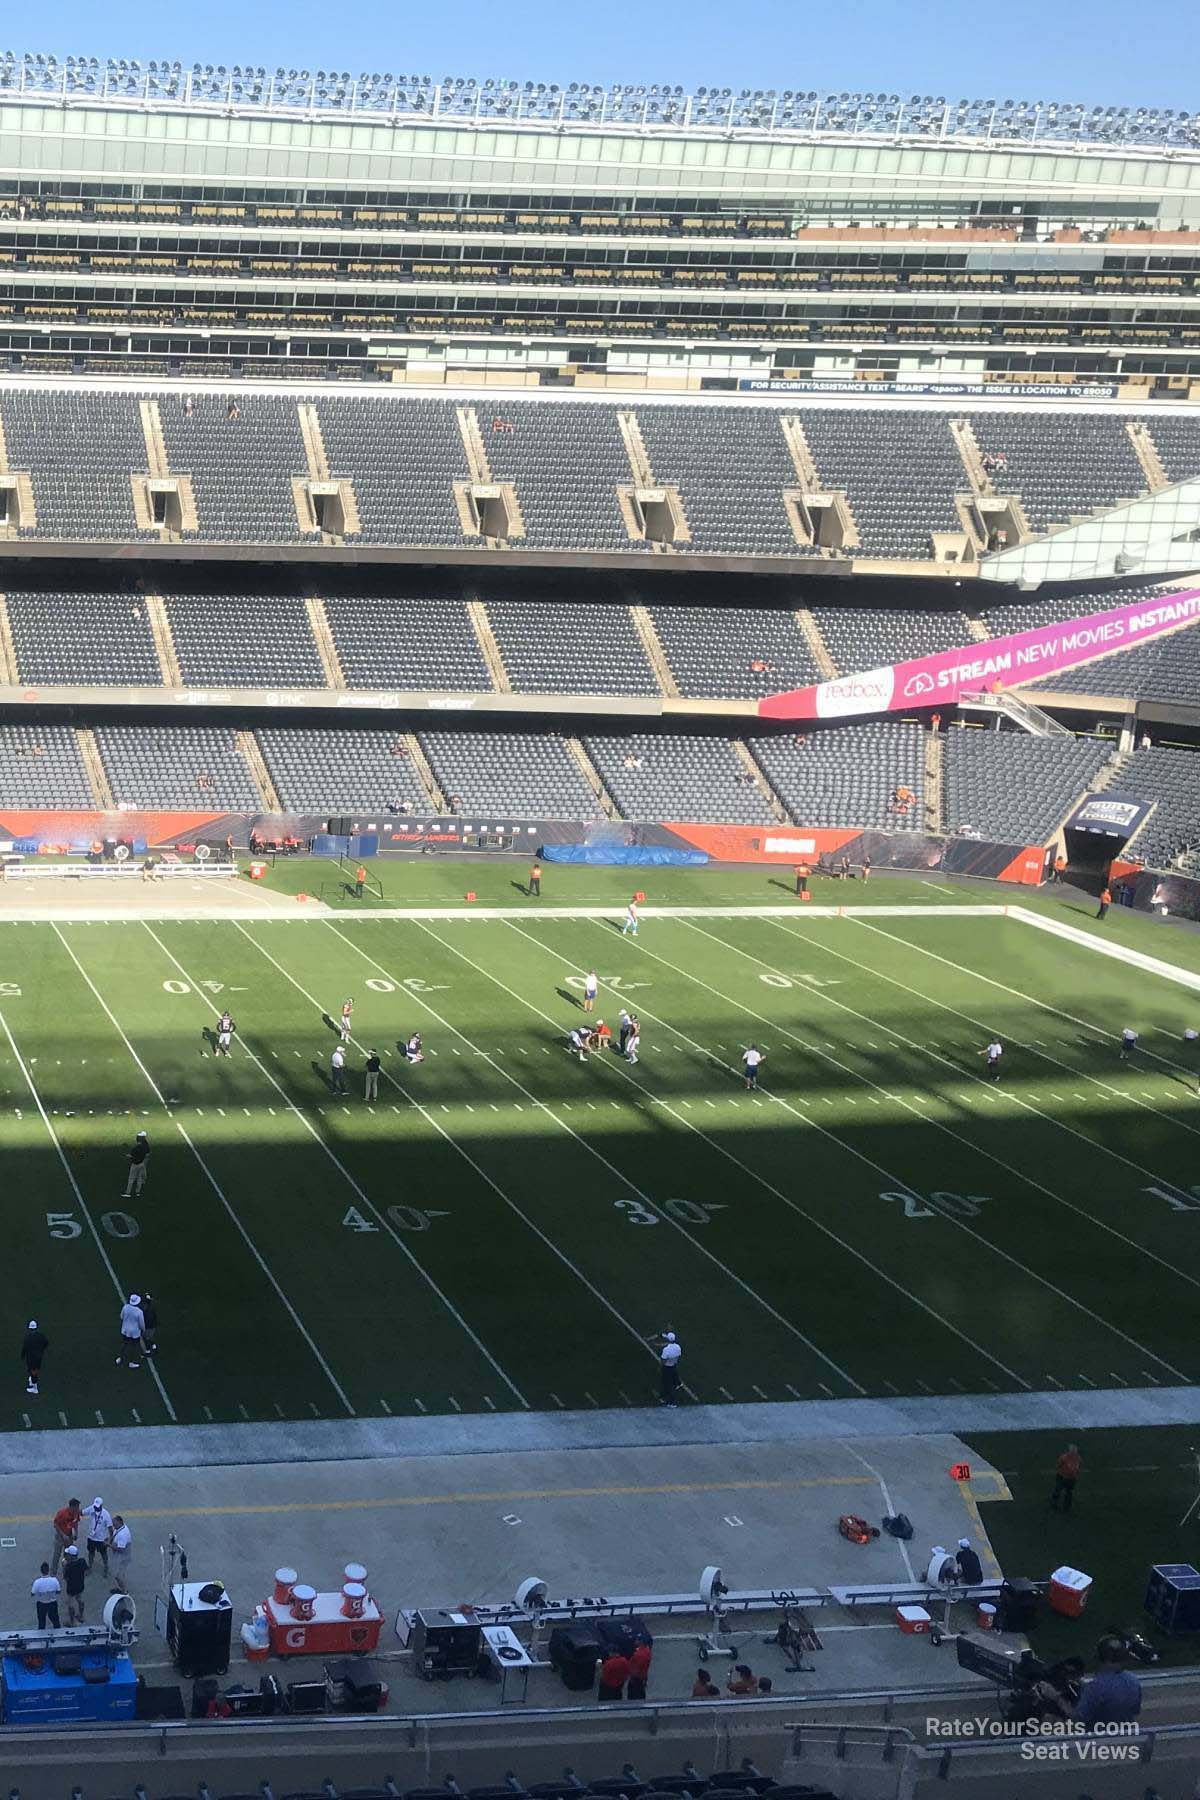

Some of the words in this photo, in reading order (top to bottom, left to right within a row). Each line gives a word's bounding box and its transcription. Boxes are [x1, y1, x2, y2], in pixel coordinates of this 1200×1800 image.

[751, 381, 768, 389] FOR
[868, 383, 889, 391] TEXT
[986, 386, 1011, 394] ISSUE
[1021, 387, 1069, 395] LOCATION
[1084, 388, 1113, 396] 69050
[937, 653, 1012, 688] STREAM
[1017, 640, 1058, 665] NEW
[1062, 619, 1125, 653] MOVIES
[1129, 597, 1200, 633] INSTANT
[281, 694, 306, 704] PNC
[956, 1464, 970, 1479] 30
[301, 1602, 310, 1611] G
[352, 1600, 361, 1609] G
[913, 1623, 924, 1633] G
[286, 1627, 306, 1648] G
